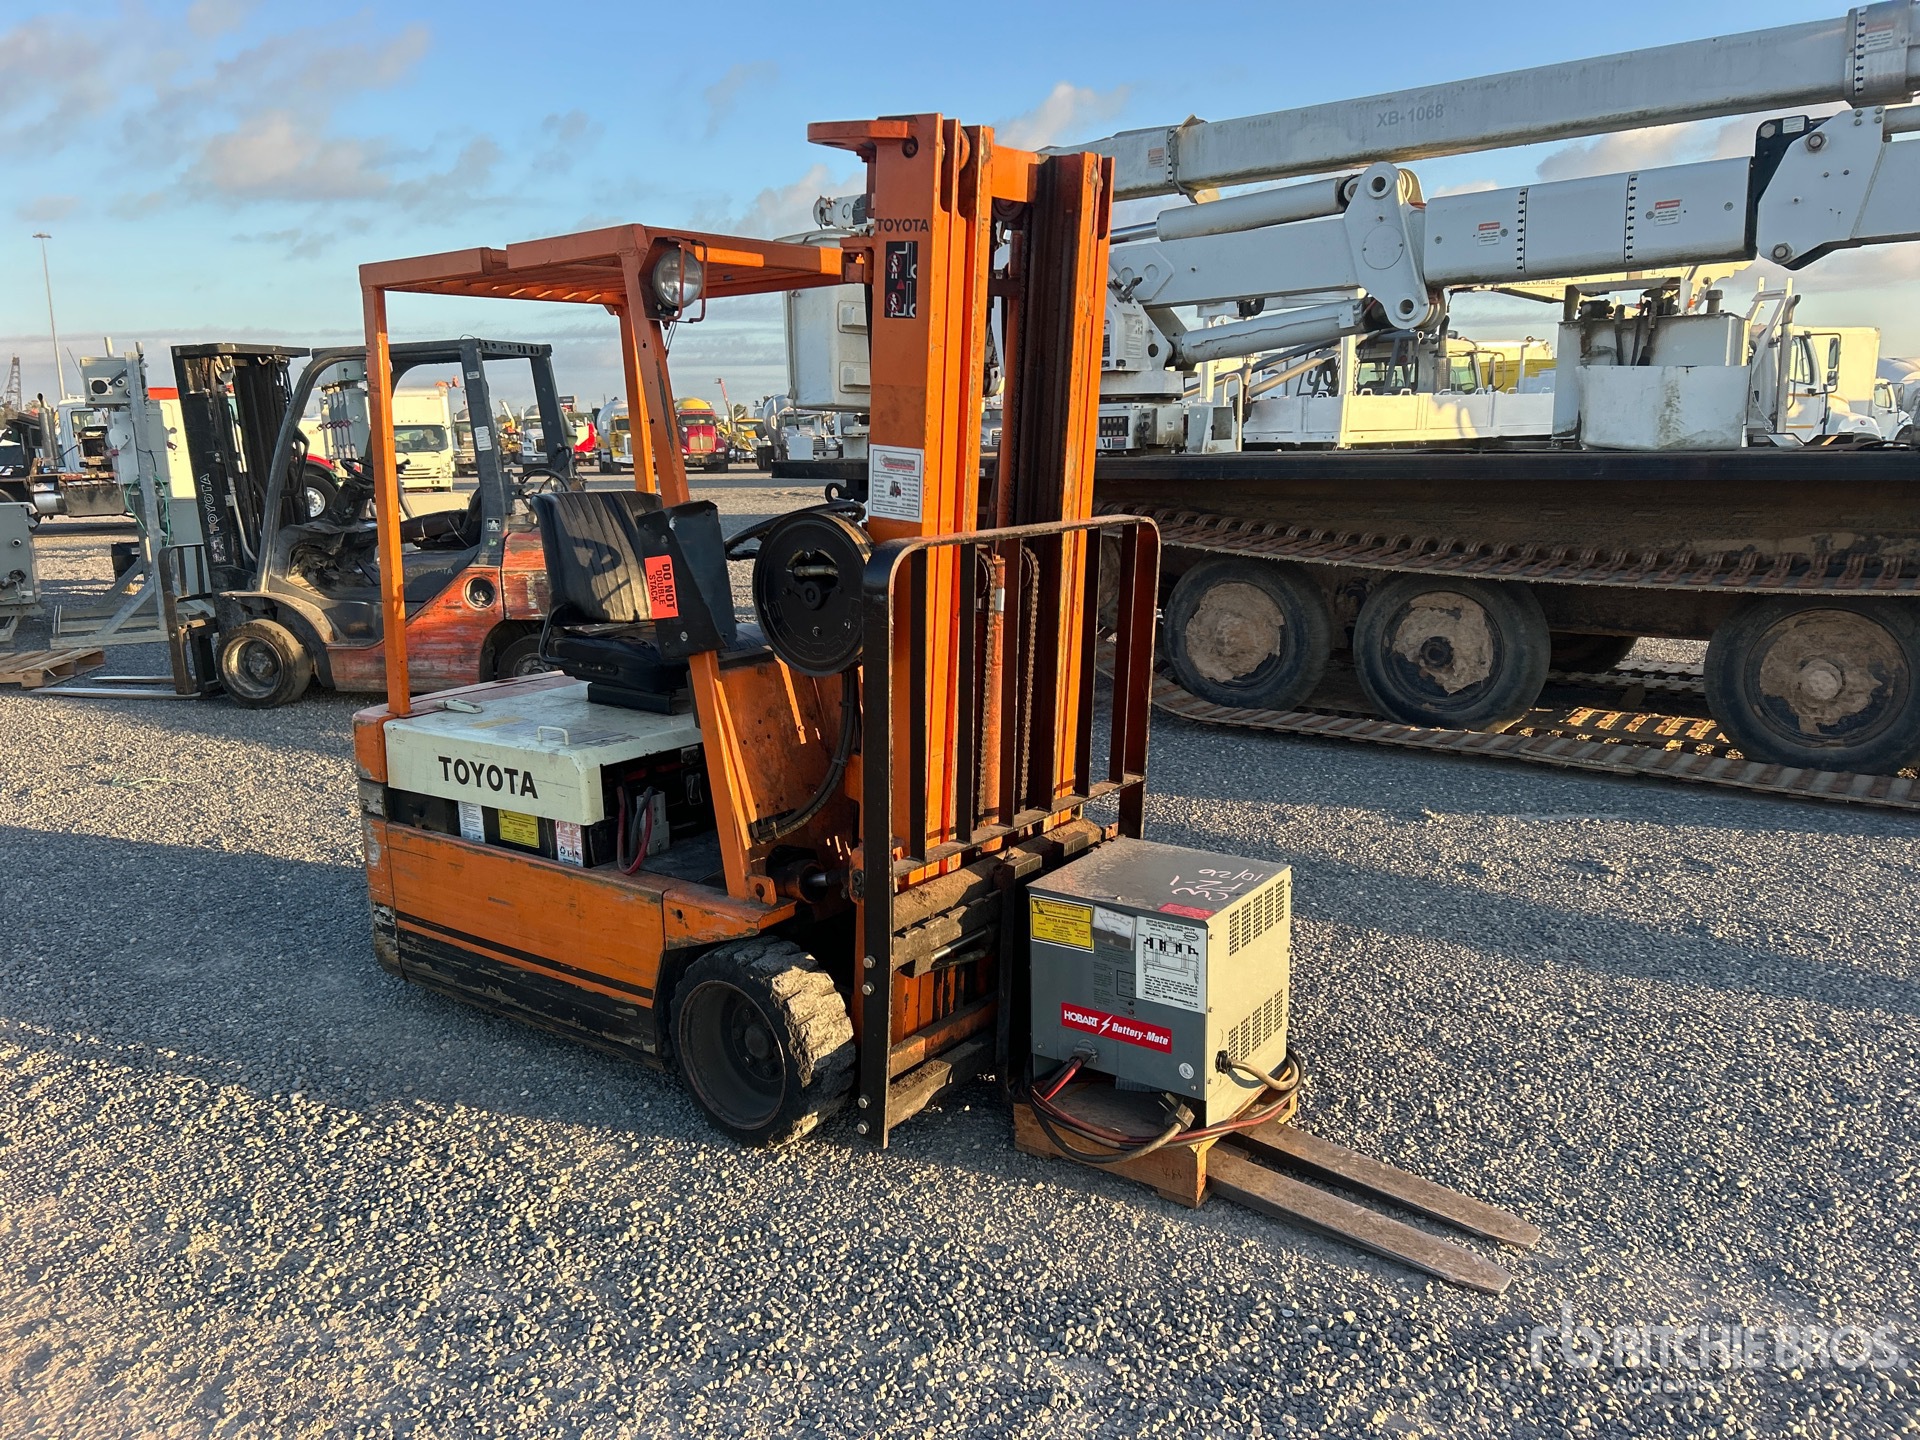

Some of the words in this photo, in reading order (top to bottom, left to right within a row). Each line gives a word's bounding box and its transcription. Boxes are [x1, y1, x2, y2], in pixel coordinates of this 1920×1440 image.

[1376, 104, 1444, 127] XB-1068
[876, 218, 929, 232] TOYOTA
[200, 473, 220, 535] TOYOTA
[662, 563, 672, 580] DO
[649, 575, 658, 602] STACK
[655, 569, 666, 605] DOUBLE
[665, 585, 675, 609] NOT
[438, 755, 539, 799] TOYOTA
[1064, 1010, 1099, 1027] HOBART
[1112, 1022, 1169, 1045] Battery-Mate
